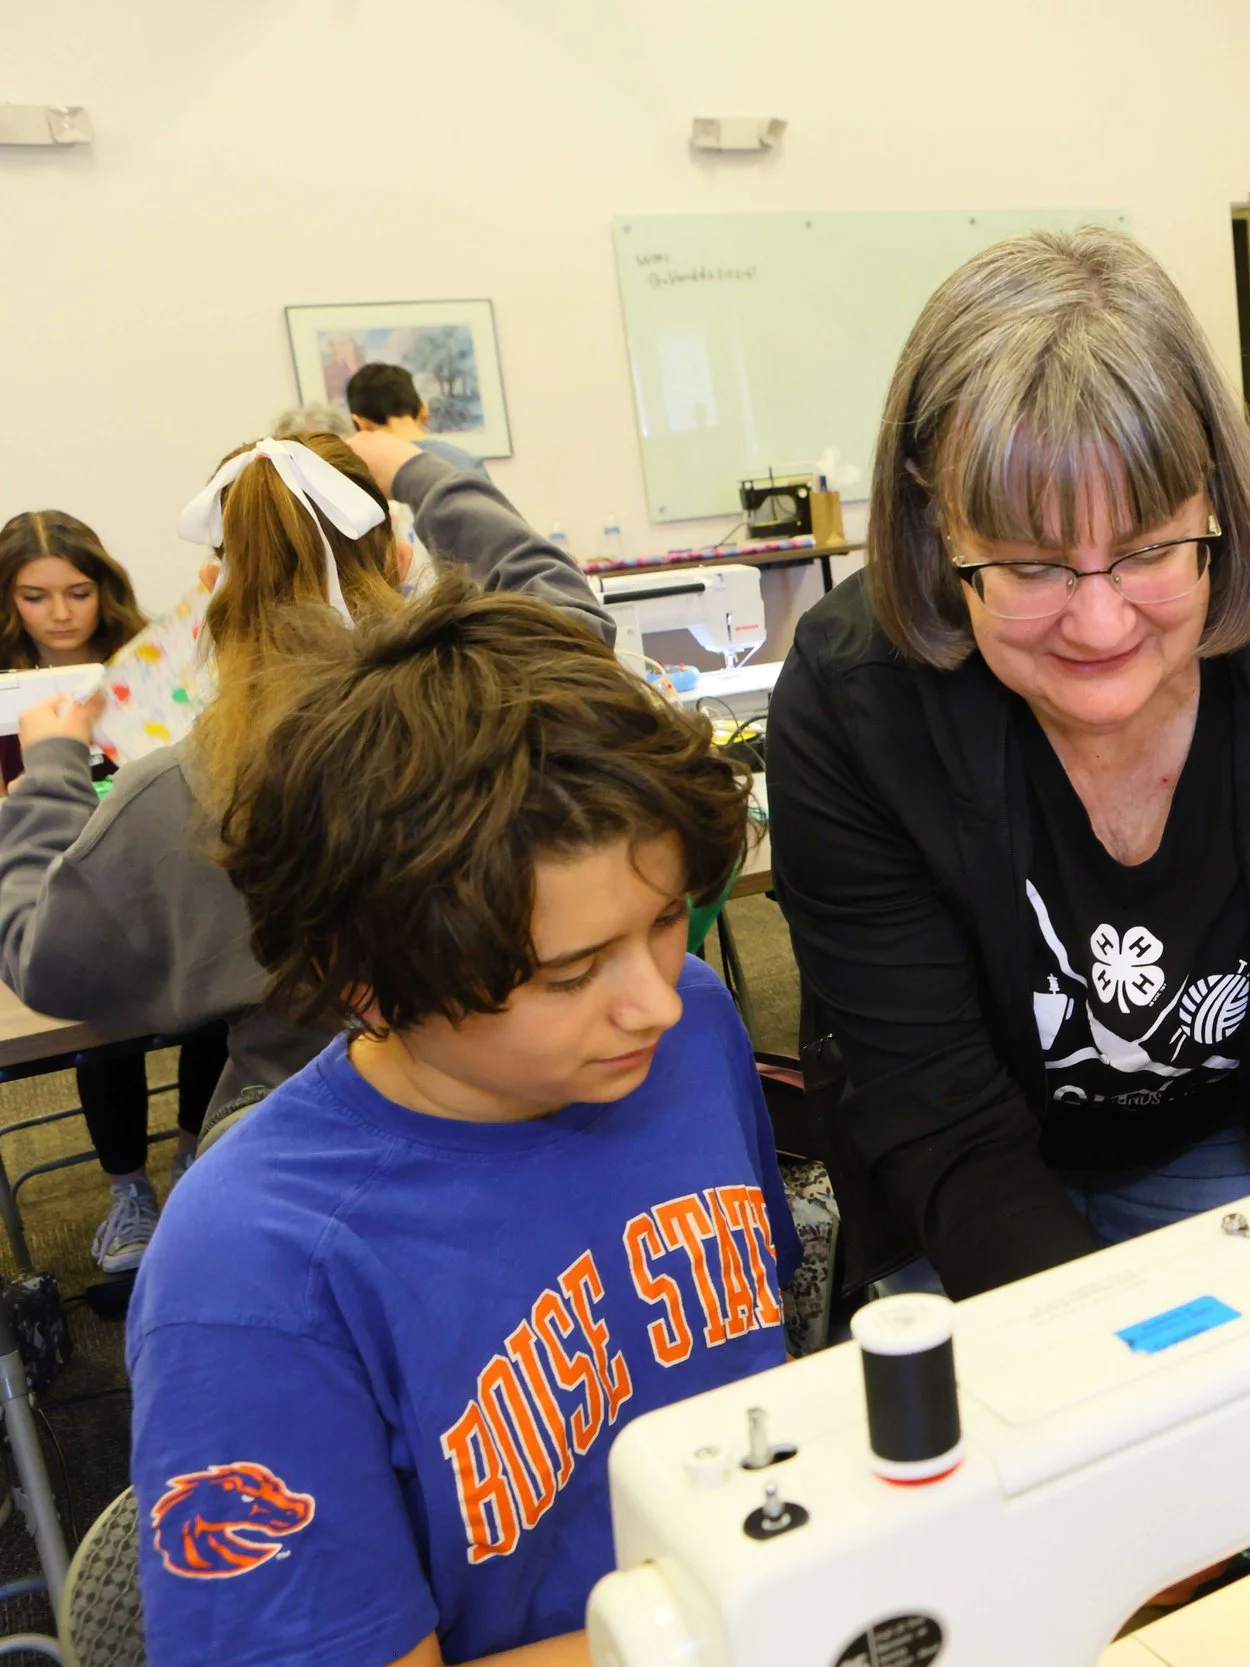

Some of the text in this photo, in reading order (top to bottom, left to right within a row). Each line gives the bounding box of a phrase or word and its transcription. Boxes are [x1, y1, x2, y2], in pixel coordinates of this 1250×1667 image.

[1096, 932, 1152, 959] H H
[1097, 969, 1155, 995] H H
[440, 1249, 632, 1564] BOISE
